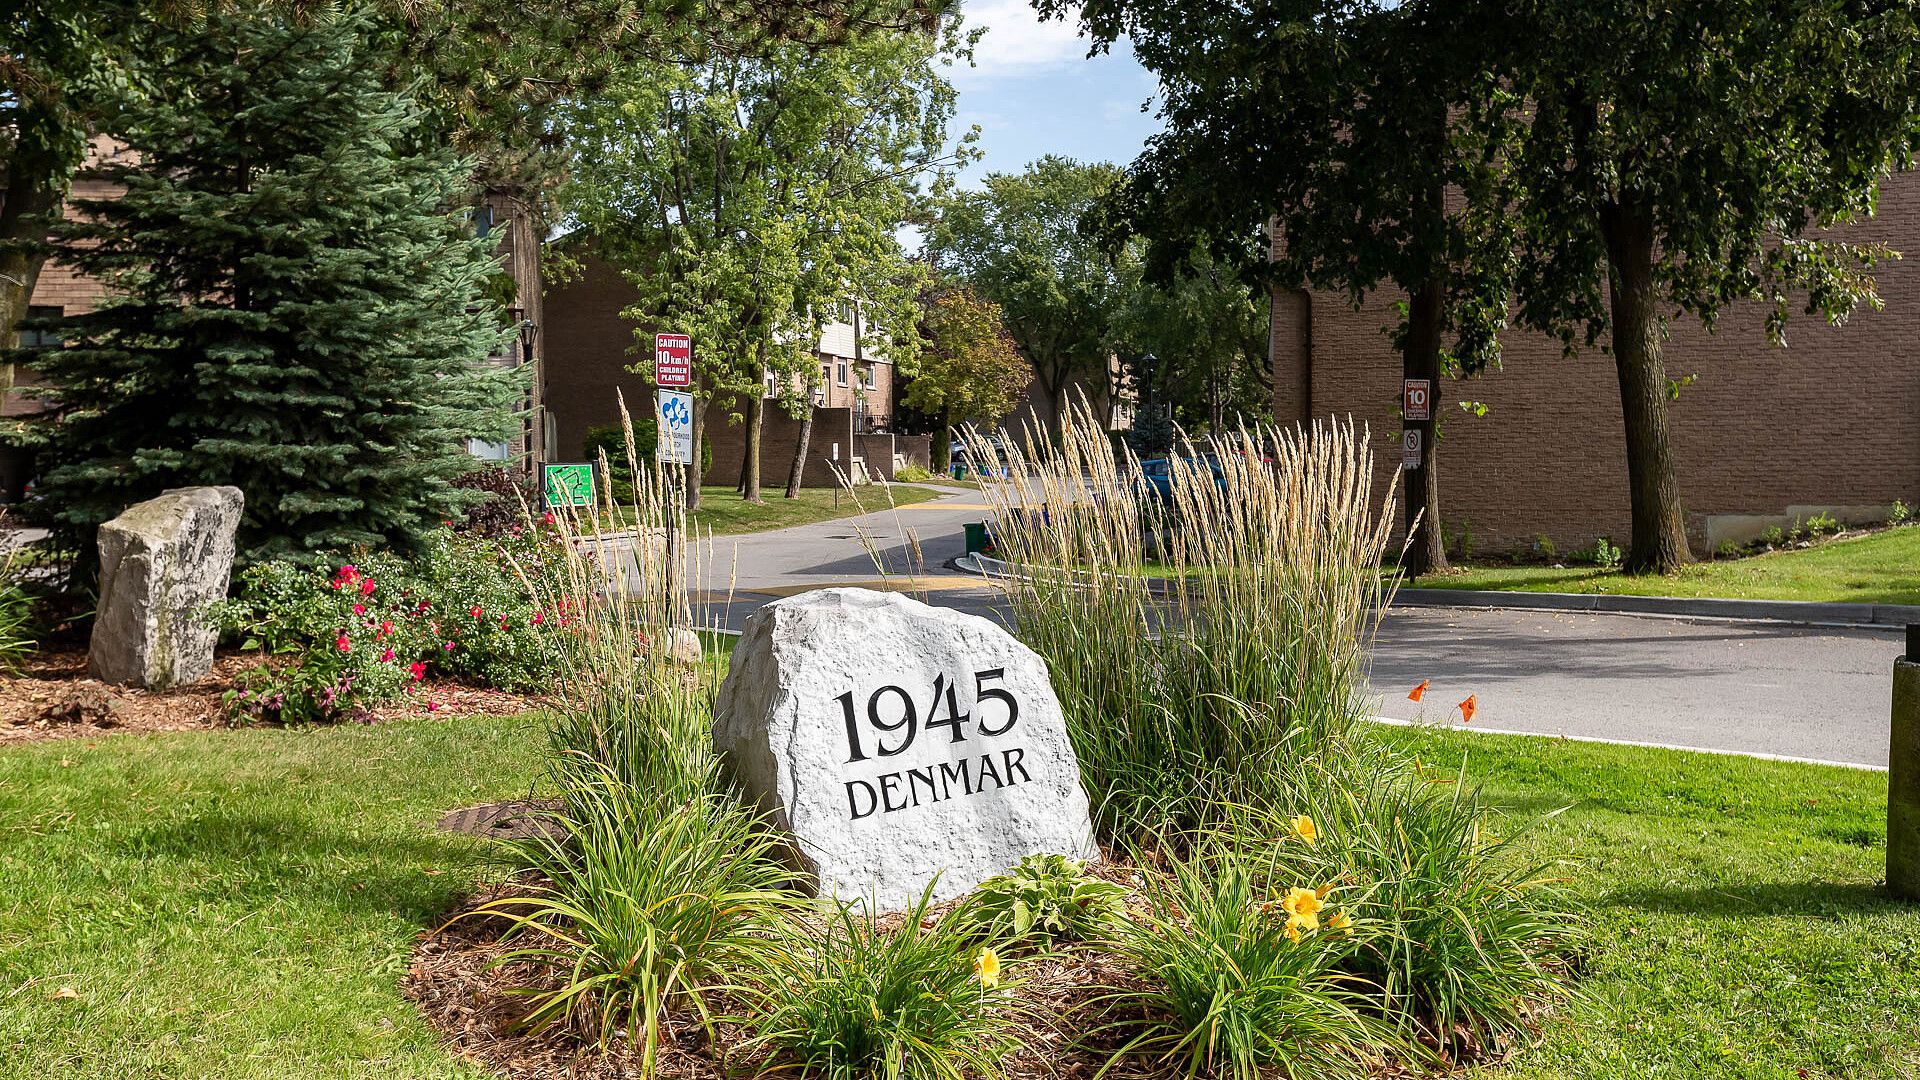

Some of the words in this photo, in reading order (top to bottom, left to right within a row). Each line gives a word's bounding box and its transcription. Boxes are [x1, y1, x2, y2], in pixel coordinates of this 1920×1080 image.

[658, 338, 688, 348] CAUTION
[658, 350, 670, 364] 10
[670, 356, 688, 365] km/h
[1408, 390, 1425, 404] 10
[832, 667, 1018, 764] 1945
[844, 748, 1032, 820] DENMAR
